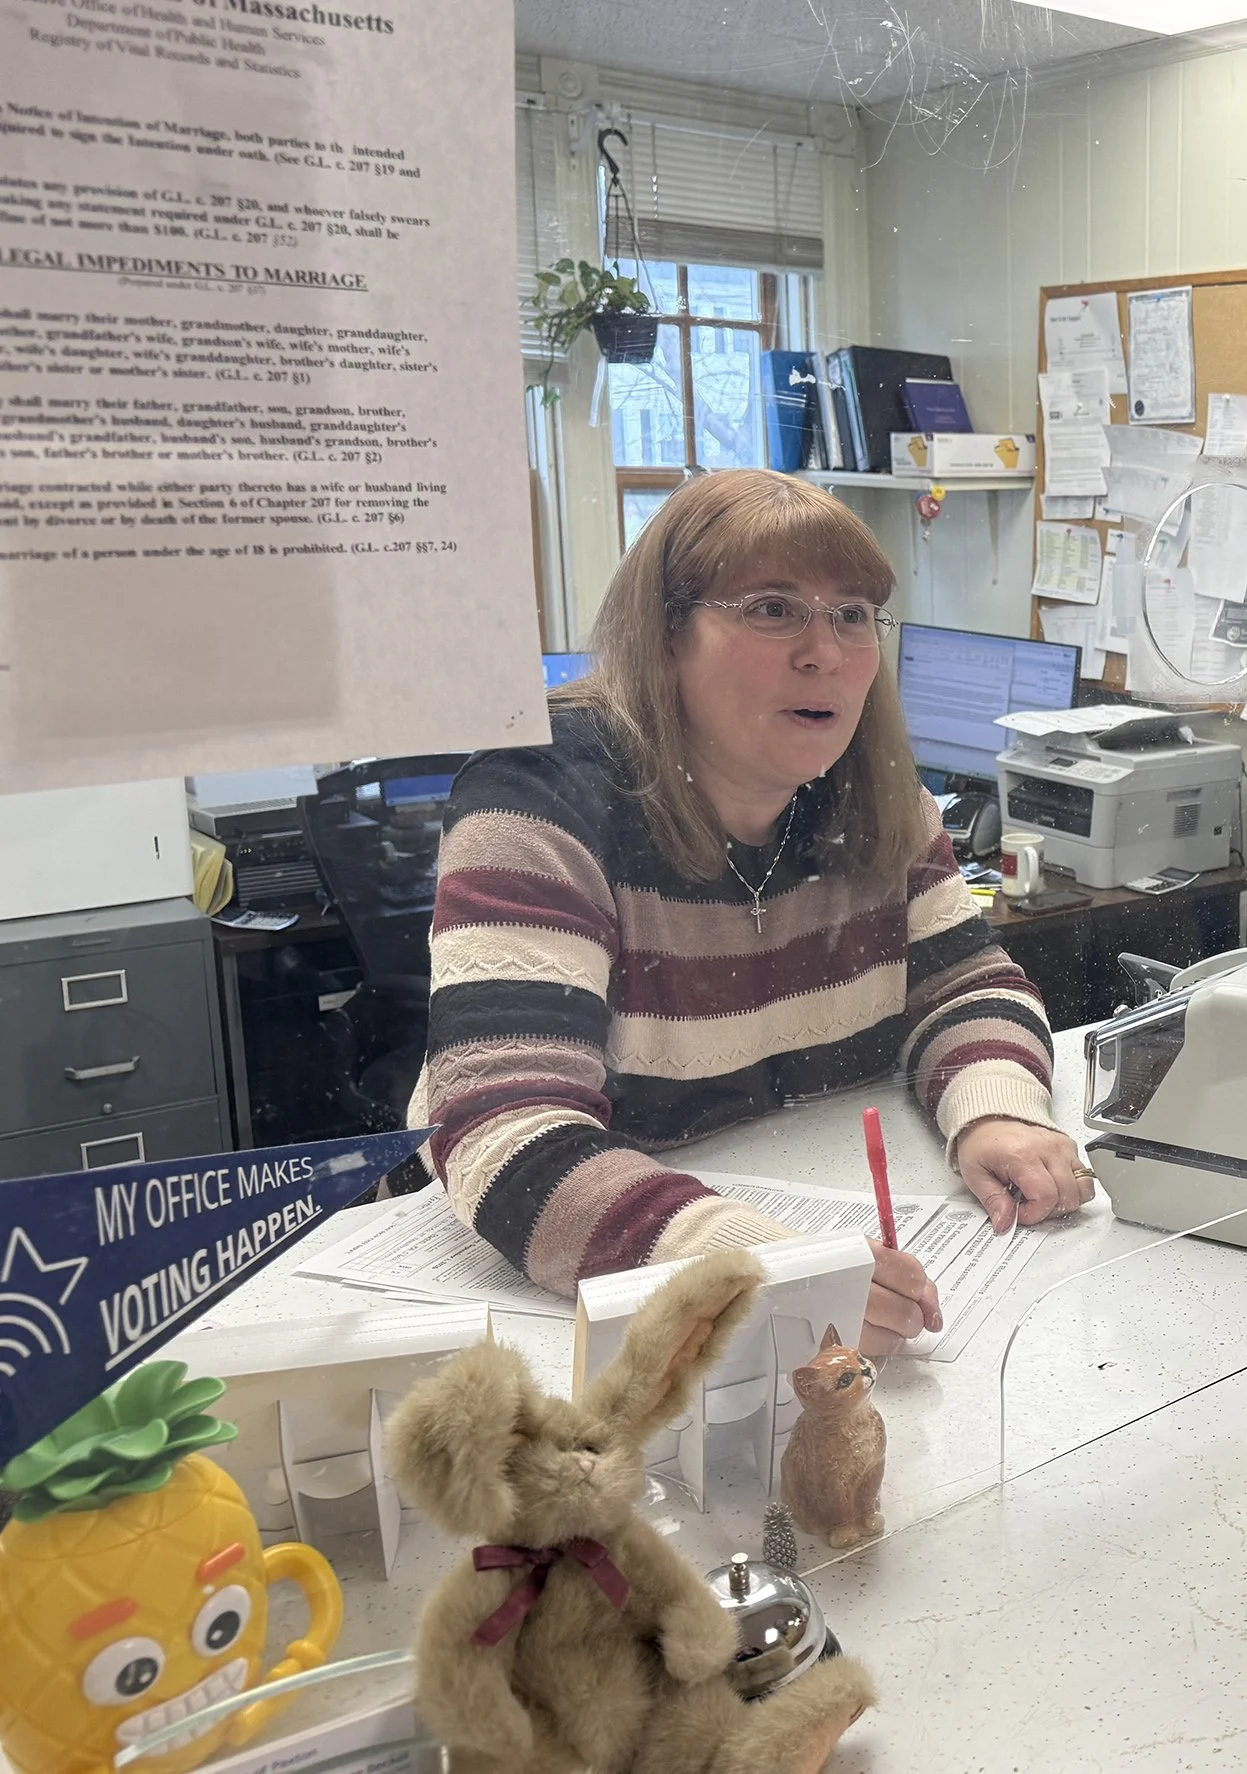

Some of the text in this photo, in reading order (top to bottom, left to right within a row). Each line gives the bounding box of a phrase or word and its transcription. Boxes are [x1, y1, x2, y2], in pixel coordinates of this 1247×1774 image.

[66, 12, 152, 38] Department
[221, 35, 266, 56] Health
[192, 15, 216, 29] and
[272, 25, 326, 47] Services
[222, 0, 394, 34] Massachusetts
[29, 26, 90, 51] Registry
[215, 57, 239, 70] and
[244, 59, 302, 79] Statistics
[76, 252, 226, 278] IMPEDIMENTS
[230, 264, 258, 281] TO
[263, 266, 368, 291] MARRIAGE
[85, 312, 119, 325] their
[181, 317, 271, 335] grandmother,
[274, 323, 333, 338] daughter,
[336, 328, 428, 344] granddaughter,
[176, 449, 234, 461] mother's
[238, 450, 289, 461] brother.
[293, 451, 325, 463] (G.L.
[328, 453, 338, 462] c.
[341, 451, 361, 462] 207
[365, 451, 383, 465] §2)
[200, 484, 233, 495] party
[238, 482, 283, 493] thereto
[286, 482, 307, 493] has
[310, 485, 318, 493] a
[320, 482, 346, 493] wife
[348, 485, 362, 493] or
[365, 482, 413, 493] husband
[416, 482, 448, 495] living
[186, 546, 206, 556] the
[210, 548, 231, 558] age
[235, 544, 250, 556] of
[252, 544, 265, 555] 18
[269, 544, 279, 554] is
[282, 543, 348, 557] prohibited.
[351, 543, 380, 555] (G.L.
[383, 542, 412, 553] c.207
[416, 541, 439, 554] §§7,
[441, 541, 458, 553] 24)
[94, 1156, 315, 1246] MY OFFICE MAKES
[100, 1248, 212, 1355] VOTING
[215, 1194, 322, 1279] HAPPEN.
